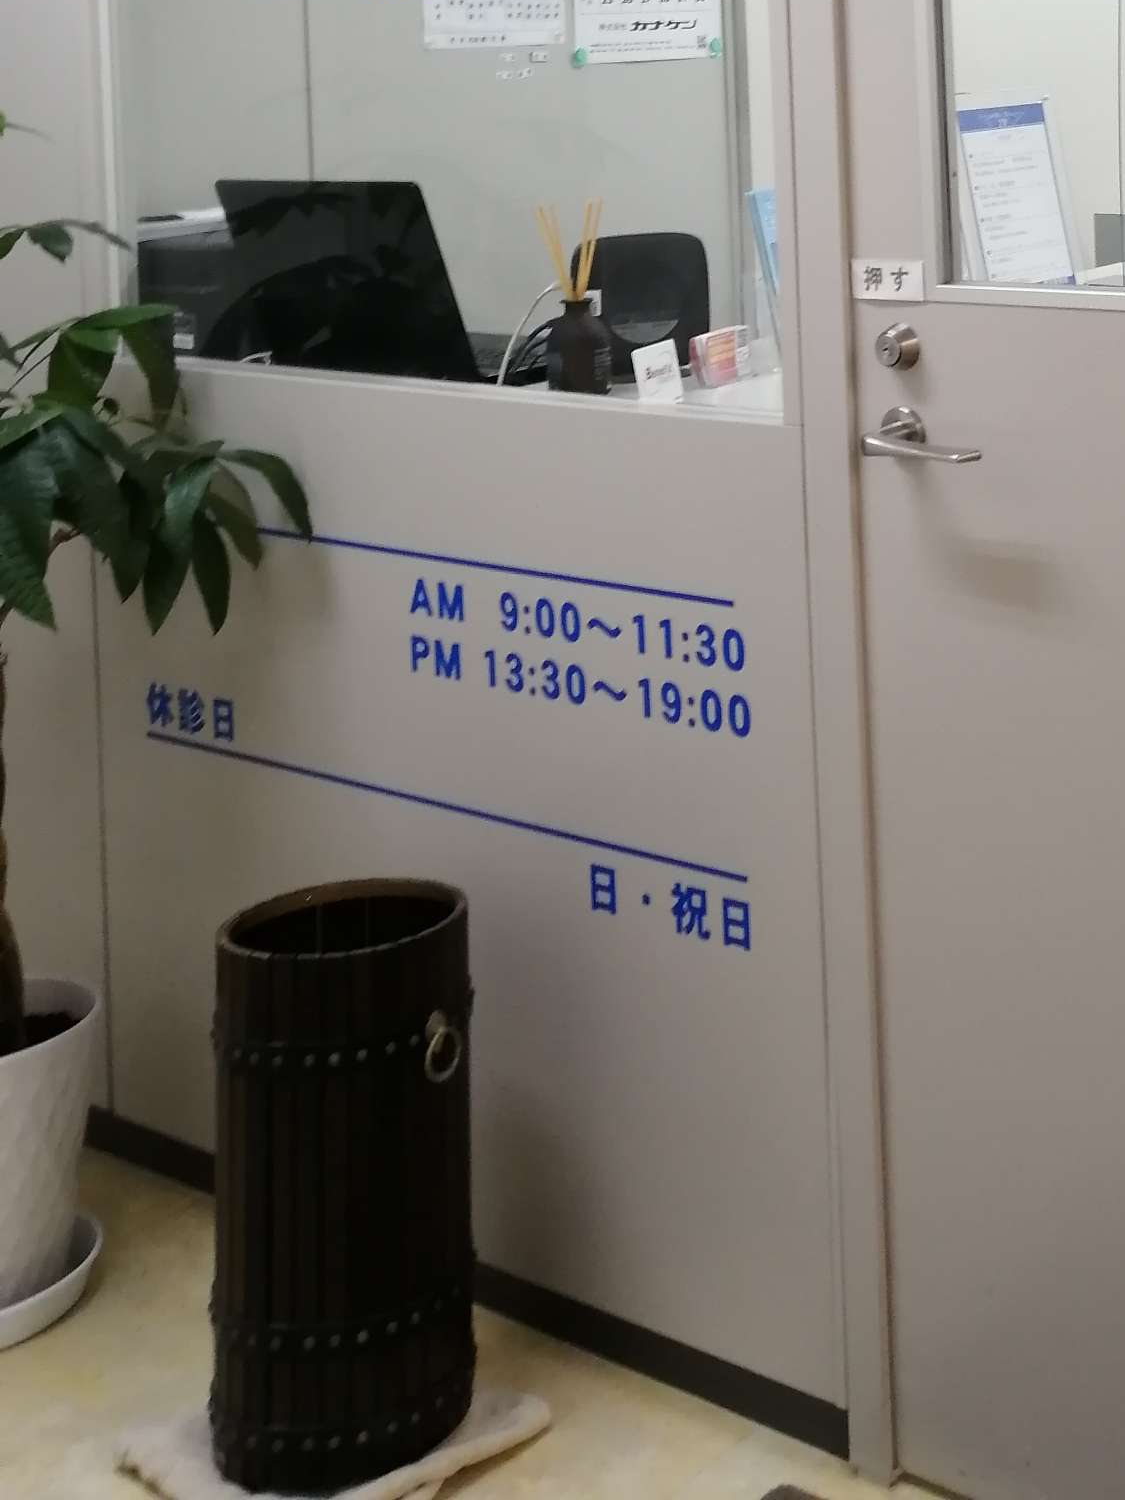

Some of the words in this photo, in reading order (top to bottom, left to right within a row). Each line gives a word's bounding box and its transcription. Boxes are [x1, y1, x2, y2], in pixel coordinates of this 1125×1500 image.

[630, 19, 698, 32] カナケン
[863, 266, 909, 291] 押す
[410, 577, 466, 622] AM
[411, 636, 462, 681] PM
[146, 682, 236, 743] 休診日
